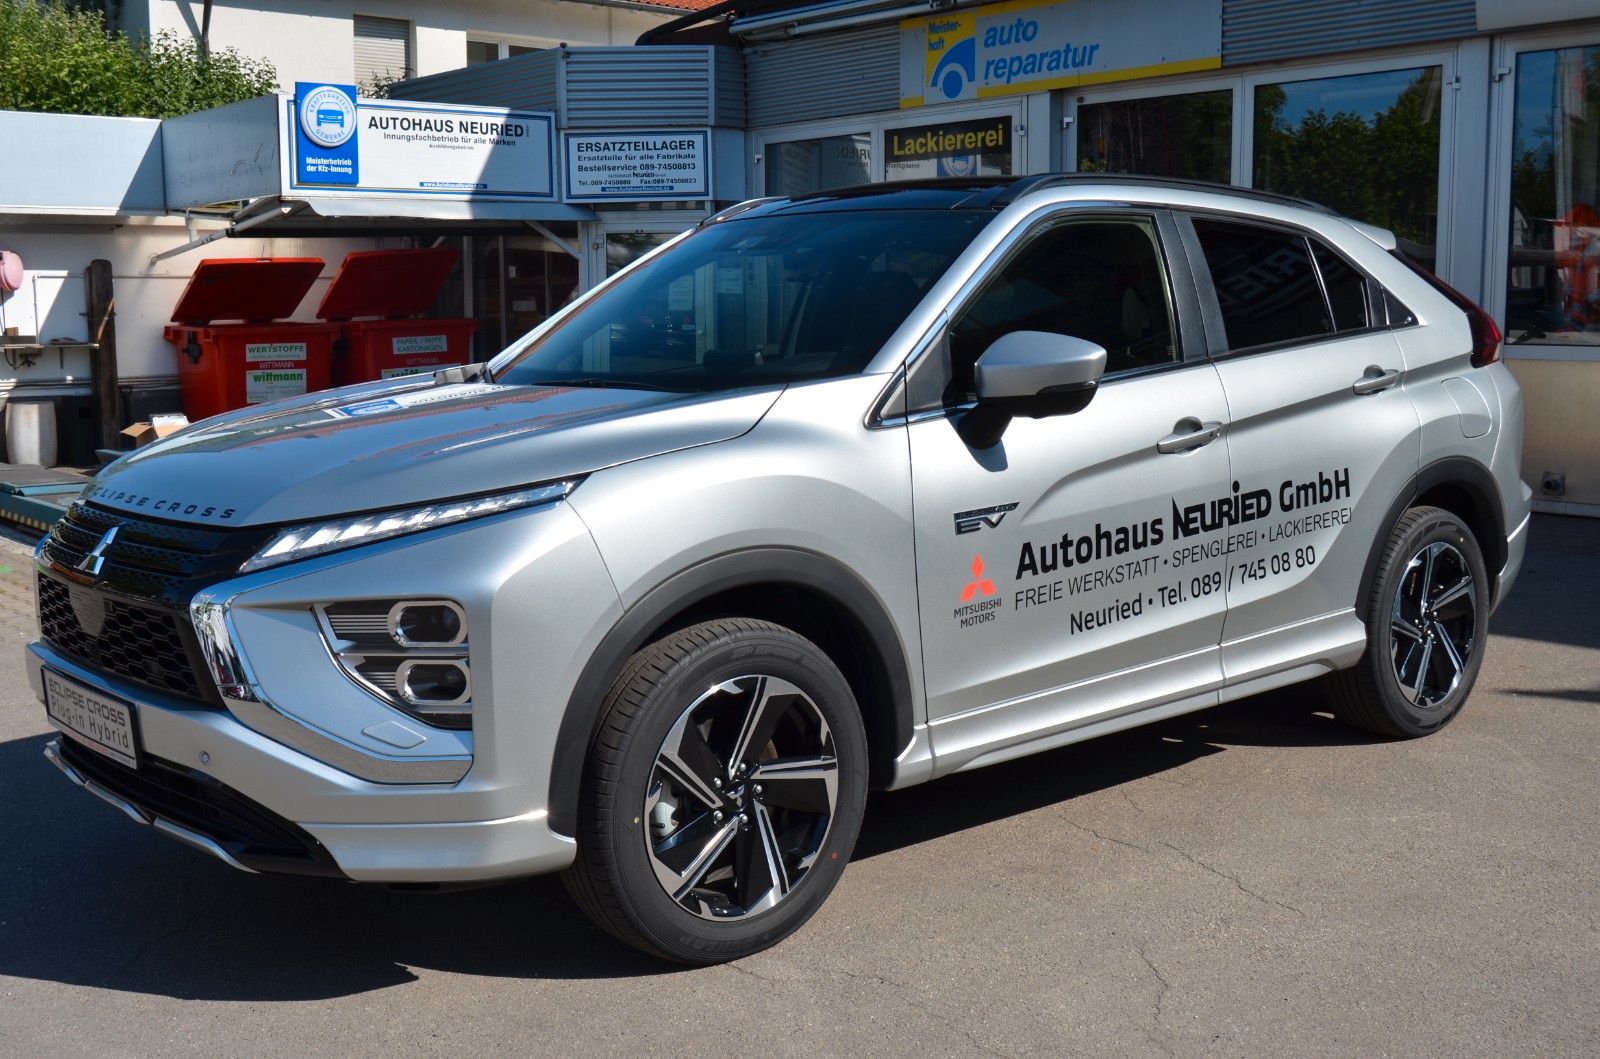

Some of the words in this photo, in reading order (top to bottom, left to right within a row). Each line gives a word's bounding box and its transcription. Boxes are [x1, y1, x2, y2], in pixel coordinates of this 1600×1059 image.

[927, 20, 962, 36] Meister-
[983, 17, 1038, 48] auto
[927, 37, 945, 53] haft
[984, 41, 1099, 85] reparatur
[368, 116, 454, 133] AUTOHAUS
[459, 121, 524, 137] NEURIED
[383, 132, 459, 143] Innungsfachbetrieb
[488, 138, 517, 147] Marken
[577, 140, 696, 152] ERSATZTEILLAGER
[892, 123, 1005, 158] Lackiererei
[305, 157, 352, 166] Meisterbetrieb
[577, 154, 623, 162] Ersatzteile
[306, 164, 317, 172] der
[318, 164, 353, 174] Kfz-Innung
[577, 163, 638, 172] Bestellservice
[639, 162, 697, 171] 089-74508813
[247, 345, 305, 354] WERTSTOFFE
[259, 361, 295, 369] WITTMANN
[252, 371, 304, 383] wittmann
[153, 499, 236, 520] CROSS
[1015, 517, 1164, 580] Autohaus
[1278, 467, 1352, 512] GmbH
[1014, 583, 1064, 611] FREIE
[1067, 556, 1160, 597] WERKSTATT
[1171, 529, 1258, 568] SPENGLEREI
[1268, 508, 1353, 543] LACKIEREREI
[1069, 593, 1143, 636] Neuried
[1157, 585, 1189, 606] Tel.
[1190, 569, 1223, 600] 089
[1238, 561, 1268, 586] 745
[1270, 553, 1293, 577] 08
[1294, 545, 1317, 569] 80
[953, 597, 1003, 619] MITSUBISHI
[960, 612, 997, 629] MOTORS
[48, 678, 85, 711] ECLIPSE
[86, 697, 126, 728] CROSS
[89, 715, 130, 750] Hybrid
